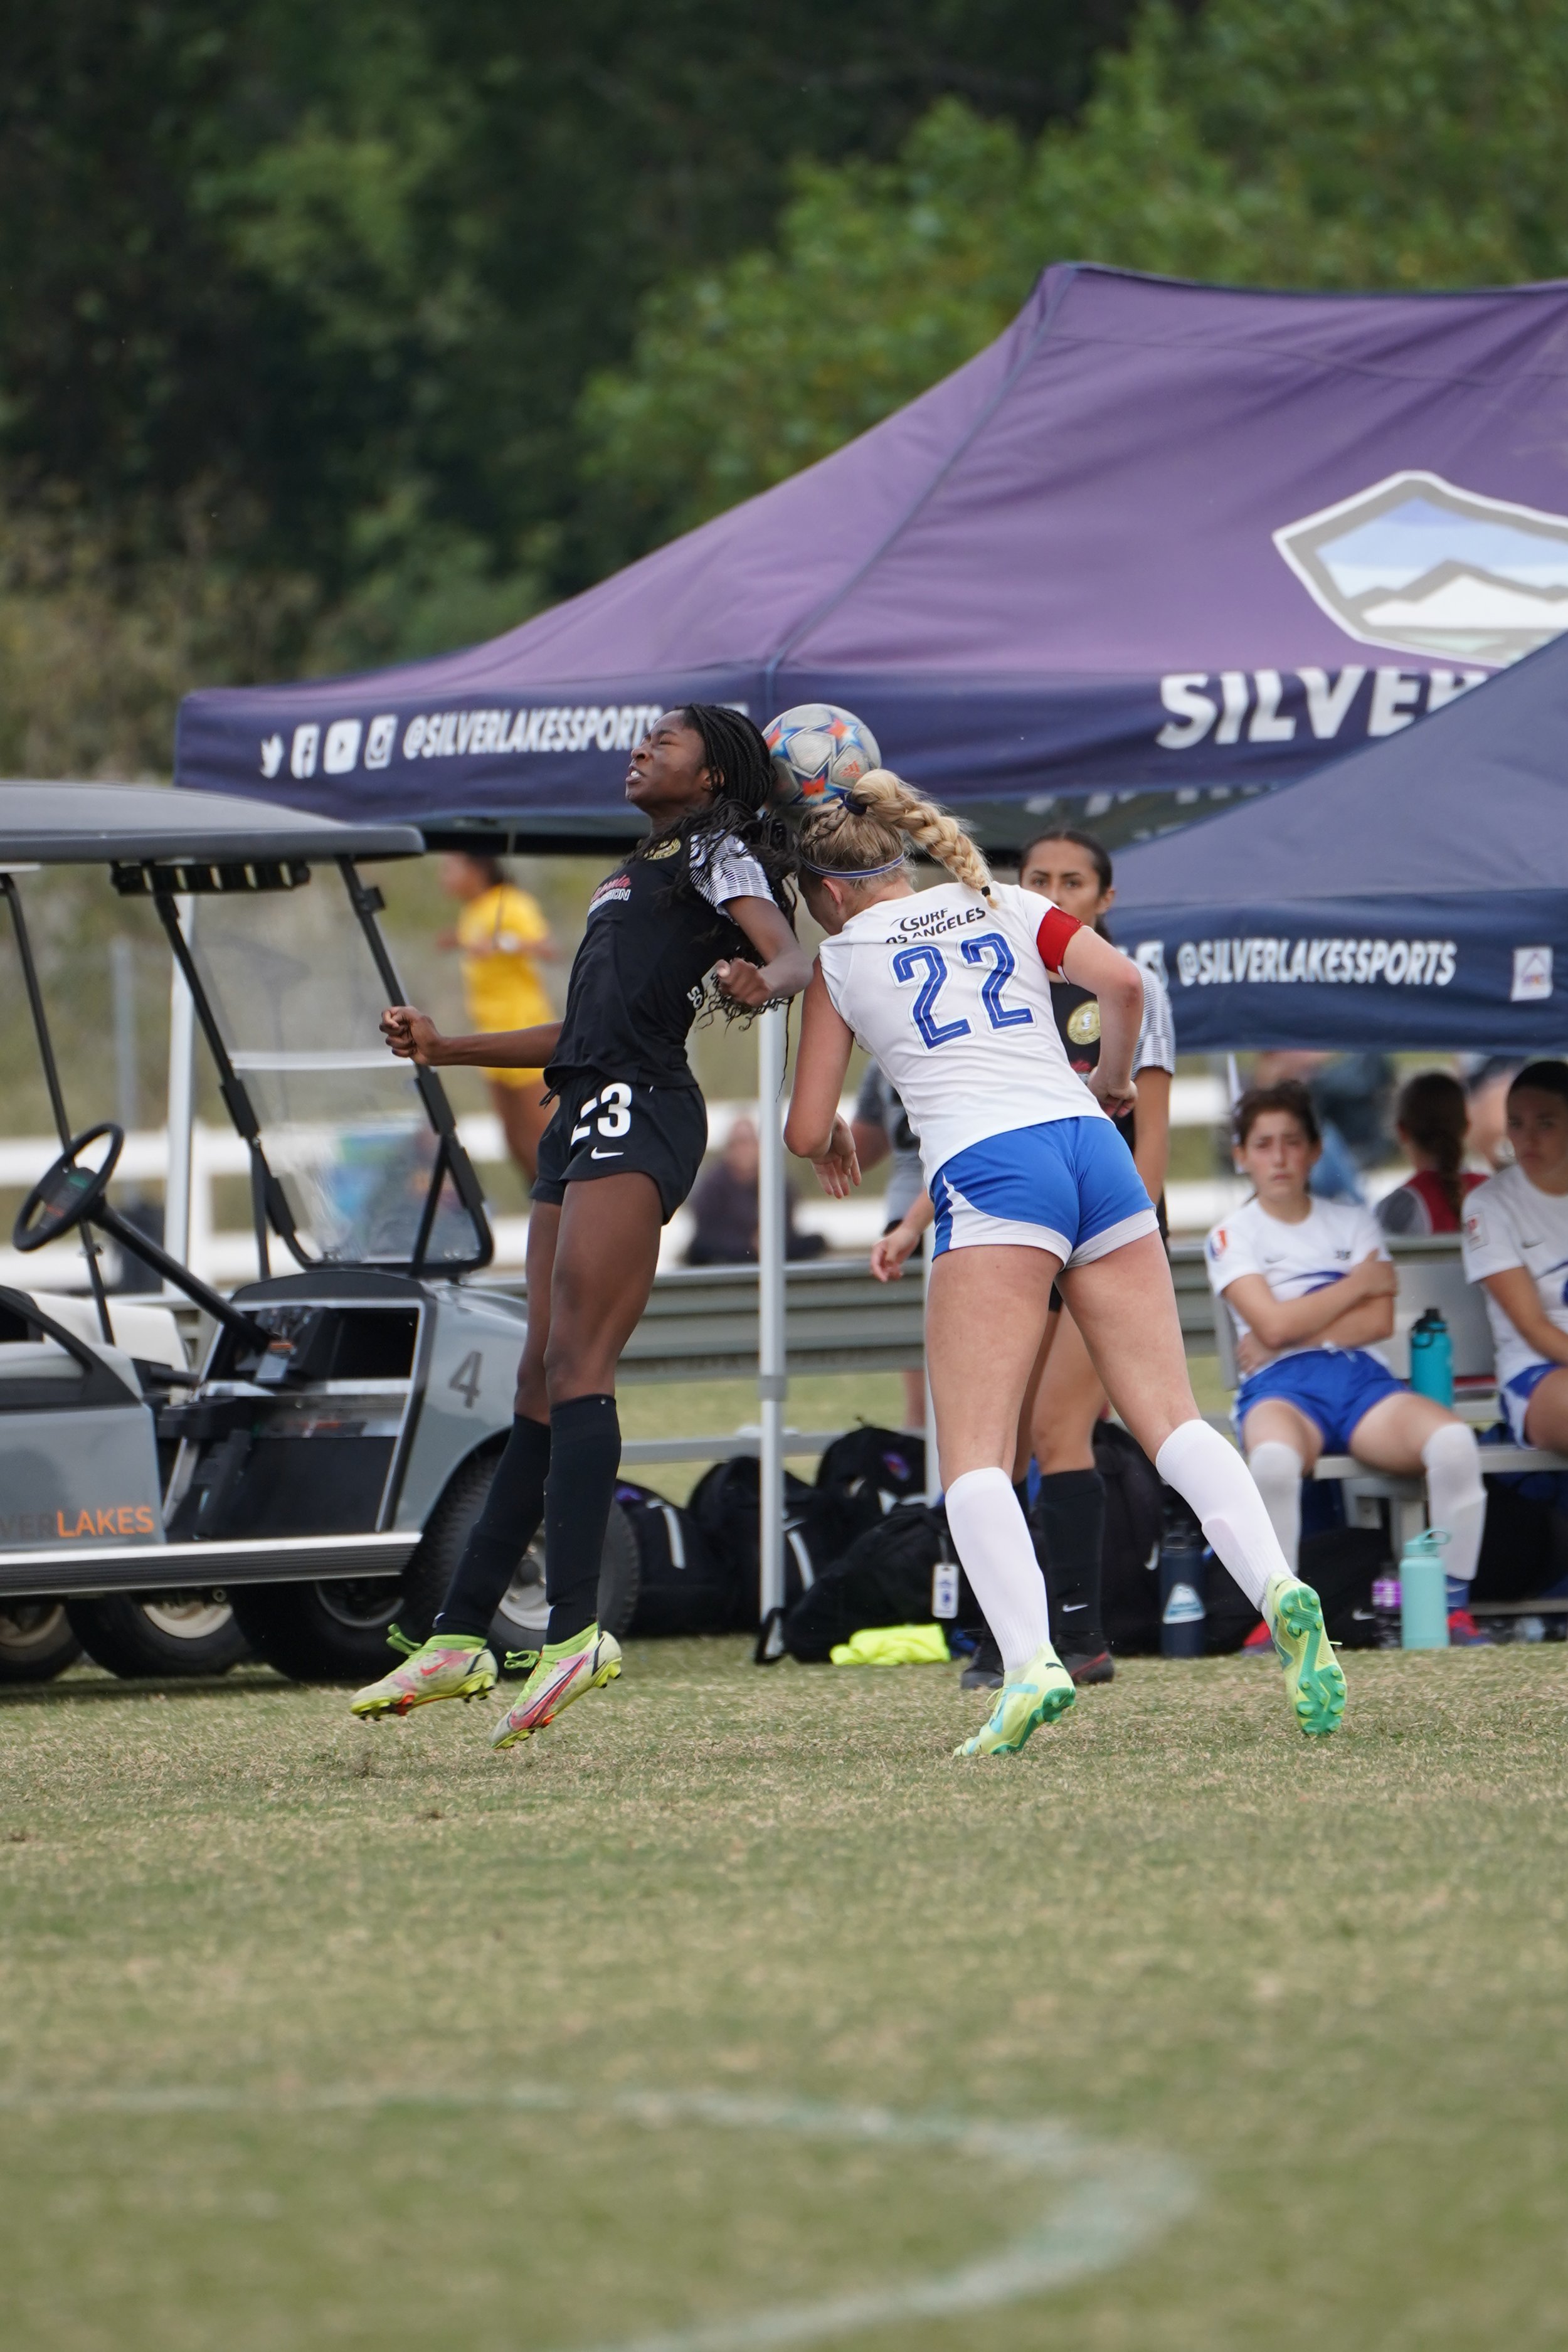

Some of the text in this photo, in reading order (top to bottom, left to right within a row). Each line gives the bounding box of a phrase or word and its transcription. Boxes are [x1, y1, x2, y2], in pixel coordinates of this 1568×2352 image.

[901, 908, 948, 931] SURF
[912, 907, 986, 939] ANGELES
[1177, 938, 1458, 987] @SILVERLAKESSPORTS
[891, 931, 1035, 1052] 22
[448, 1350, 482, 1410] 4
